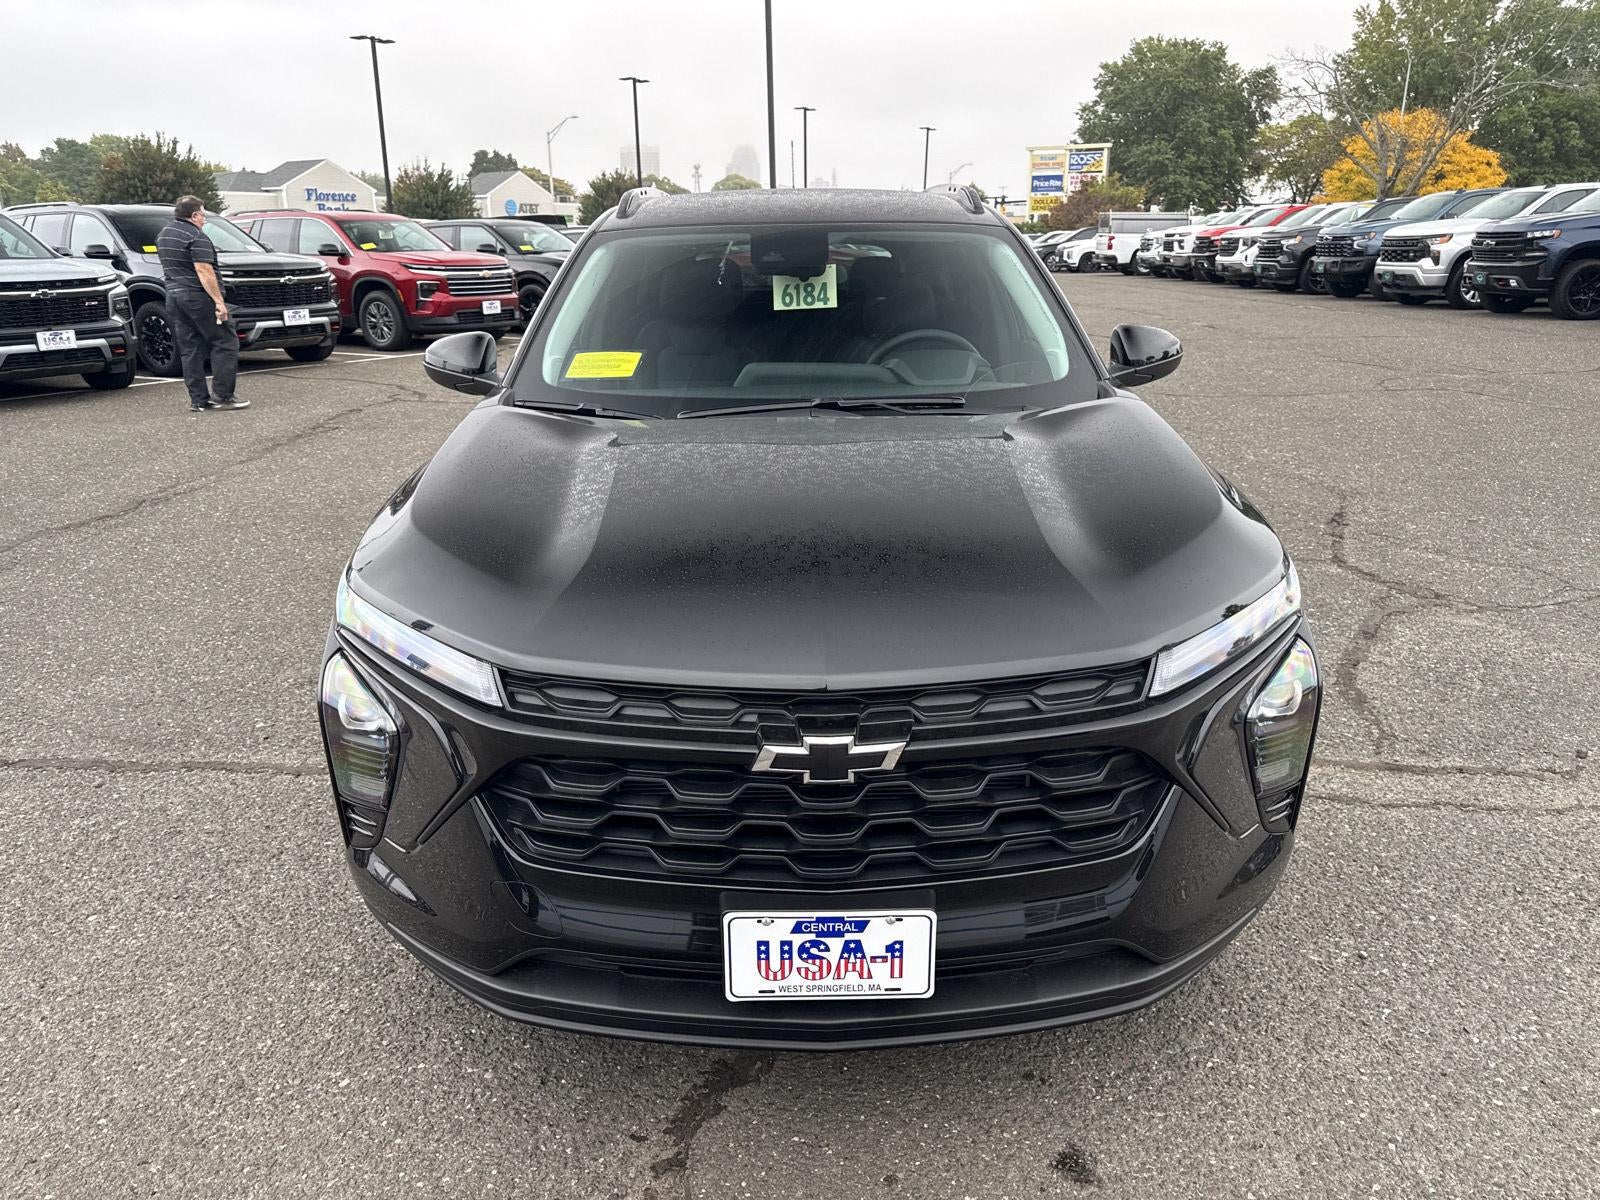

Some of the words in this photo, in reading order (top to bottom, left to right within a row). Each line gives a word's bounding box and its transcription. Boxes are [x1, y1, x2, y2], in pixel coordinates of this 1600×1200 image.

[1070, 154, 1102, 164] ROSS
[1032, 179, 1049, 187] Price
[1050, 179, 1062, 187] Rite
[305, 187, 357, 202] Florence
[518, 203, 539, 214] AT&T
[781, 281, 830, 308] 6184
[801, 922, 859, 932] CENTRAL
[756, 939, 904, 982] USA-1
[778, 985, 804, 993] WEST
[805, 984, 867, 993] SPRINGFIELD,
[868, 984, 882, 992] MA
